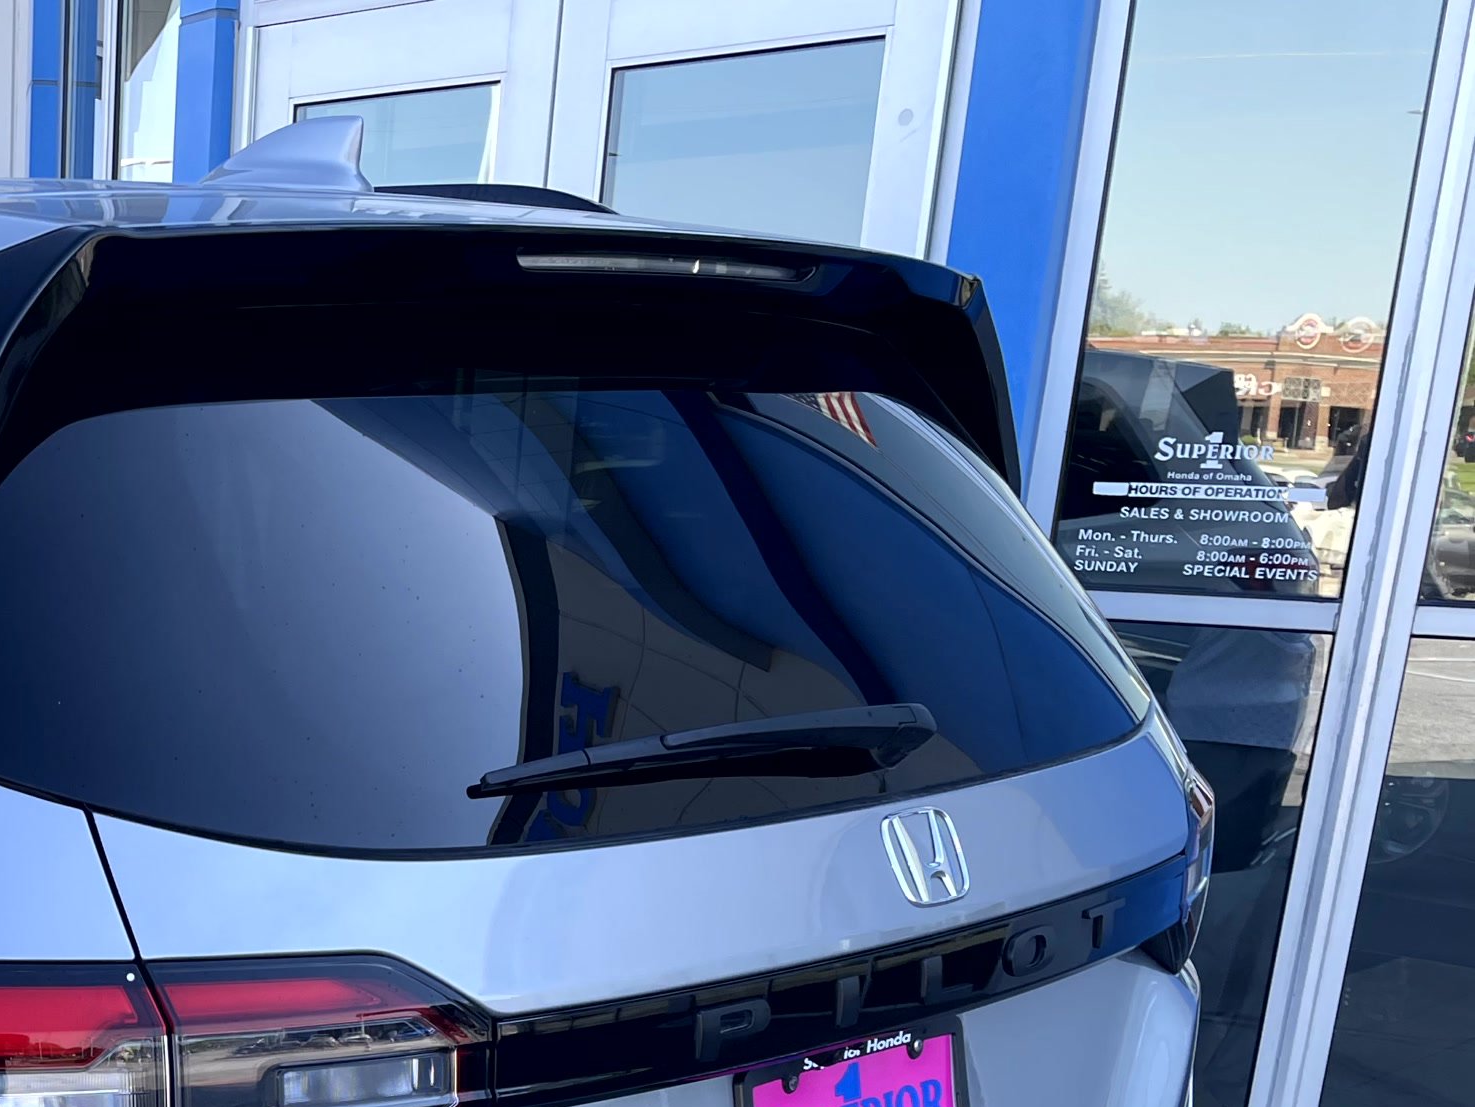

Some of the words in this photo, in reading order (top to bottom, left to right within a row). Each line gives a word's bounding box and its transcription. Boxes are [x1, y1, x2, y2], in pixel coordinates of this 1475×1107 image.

[1154, 437, 1274, 462] SUPERIOR
[1167, 471, 1200, 481] Honda
[1203, 472, 1214, 481] of
[1216, 472, 1252, 482] Omaha
[1128, 484, 1178, 496] HOURS
[1181, 486, 1201, 497] OF
[1204, 486, 1287, 500] OPERATION
[1120, 506, 1170, 520] SALES
[1174, 508, 1184, 520] &
[1189, 508, 1289, 524] SHOWROOM
[1078, 529, 1116, 542] Mon.
[1130, 530, 1178, 544] Thurs.
[1200, 534, 1248, 547] 8:00AM
[1261, 537, 1311, 550] 8:00PM
[1075, 545, 1099, 557] Fri.
[1113, 546, 1142, 559] Sat.
[1196, 550, 1245, 563] 8:00AM
[1259, 552, 1309, 566] 6:00PM
[1074, 559, 1138, 573] SUNDAY
[1182, 564, 1250, 579] SPECIAL
[1254, 567, 1318, 581] EVENTS
[695, 902, 1124, 1062] PILOT
[866, 1030, 912, 1053] Honda
